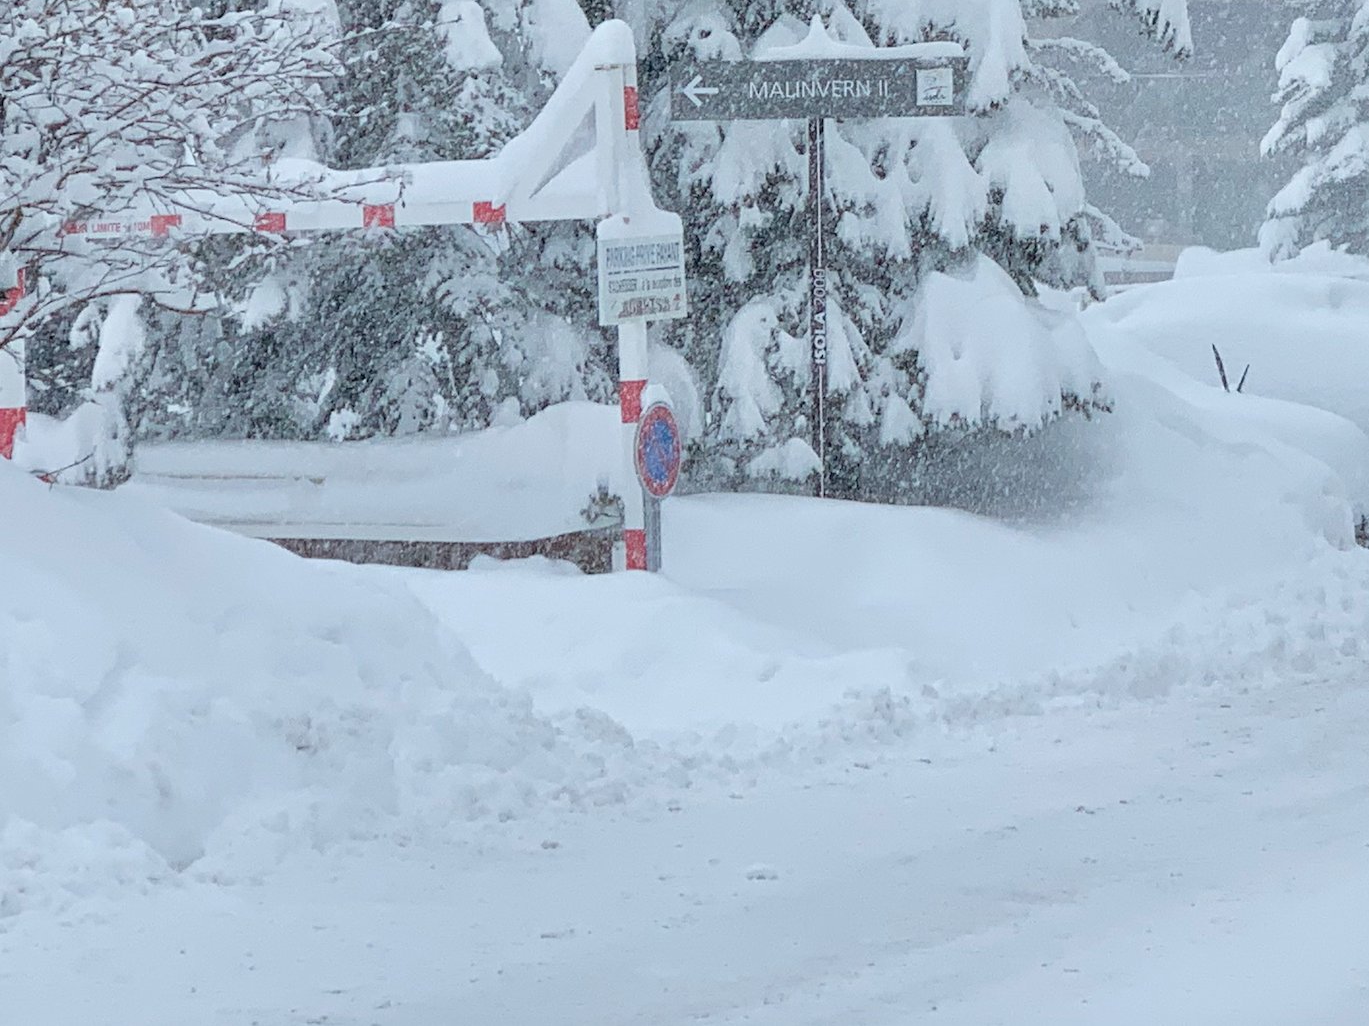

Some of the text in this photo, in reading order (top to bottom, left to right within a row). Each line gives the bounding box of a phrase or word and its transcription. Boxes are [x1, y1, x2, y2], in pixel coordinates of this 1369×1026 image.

[749, 81, 871, 99] MALINVERN
[813, 268, 826, 365] ISOLA 2000
